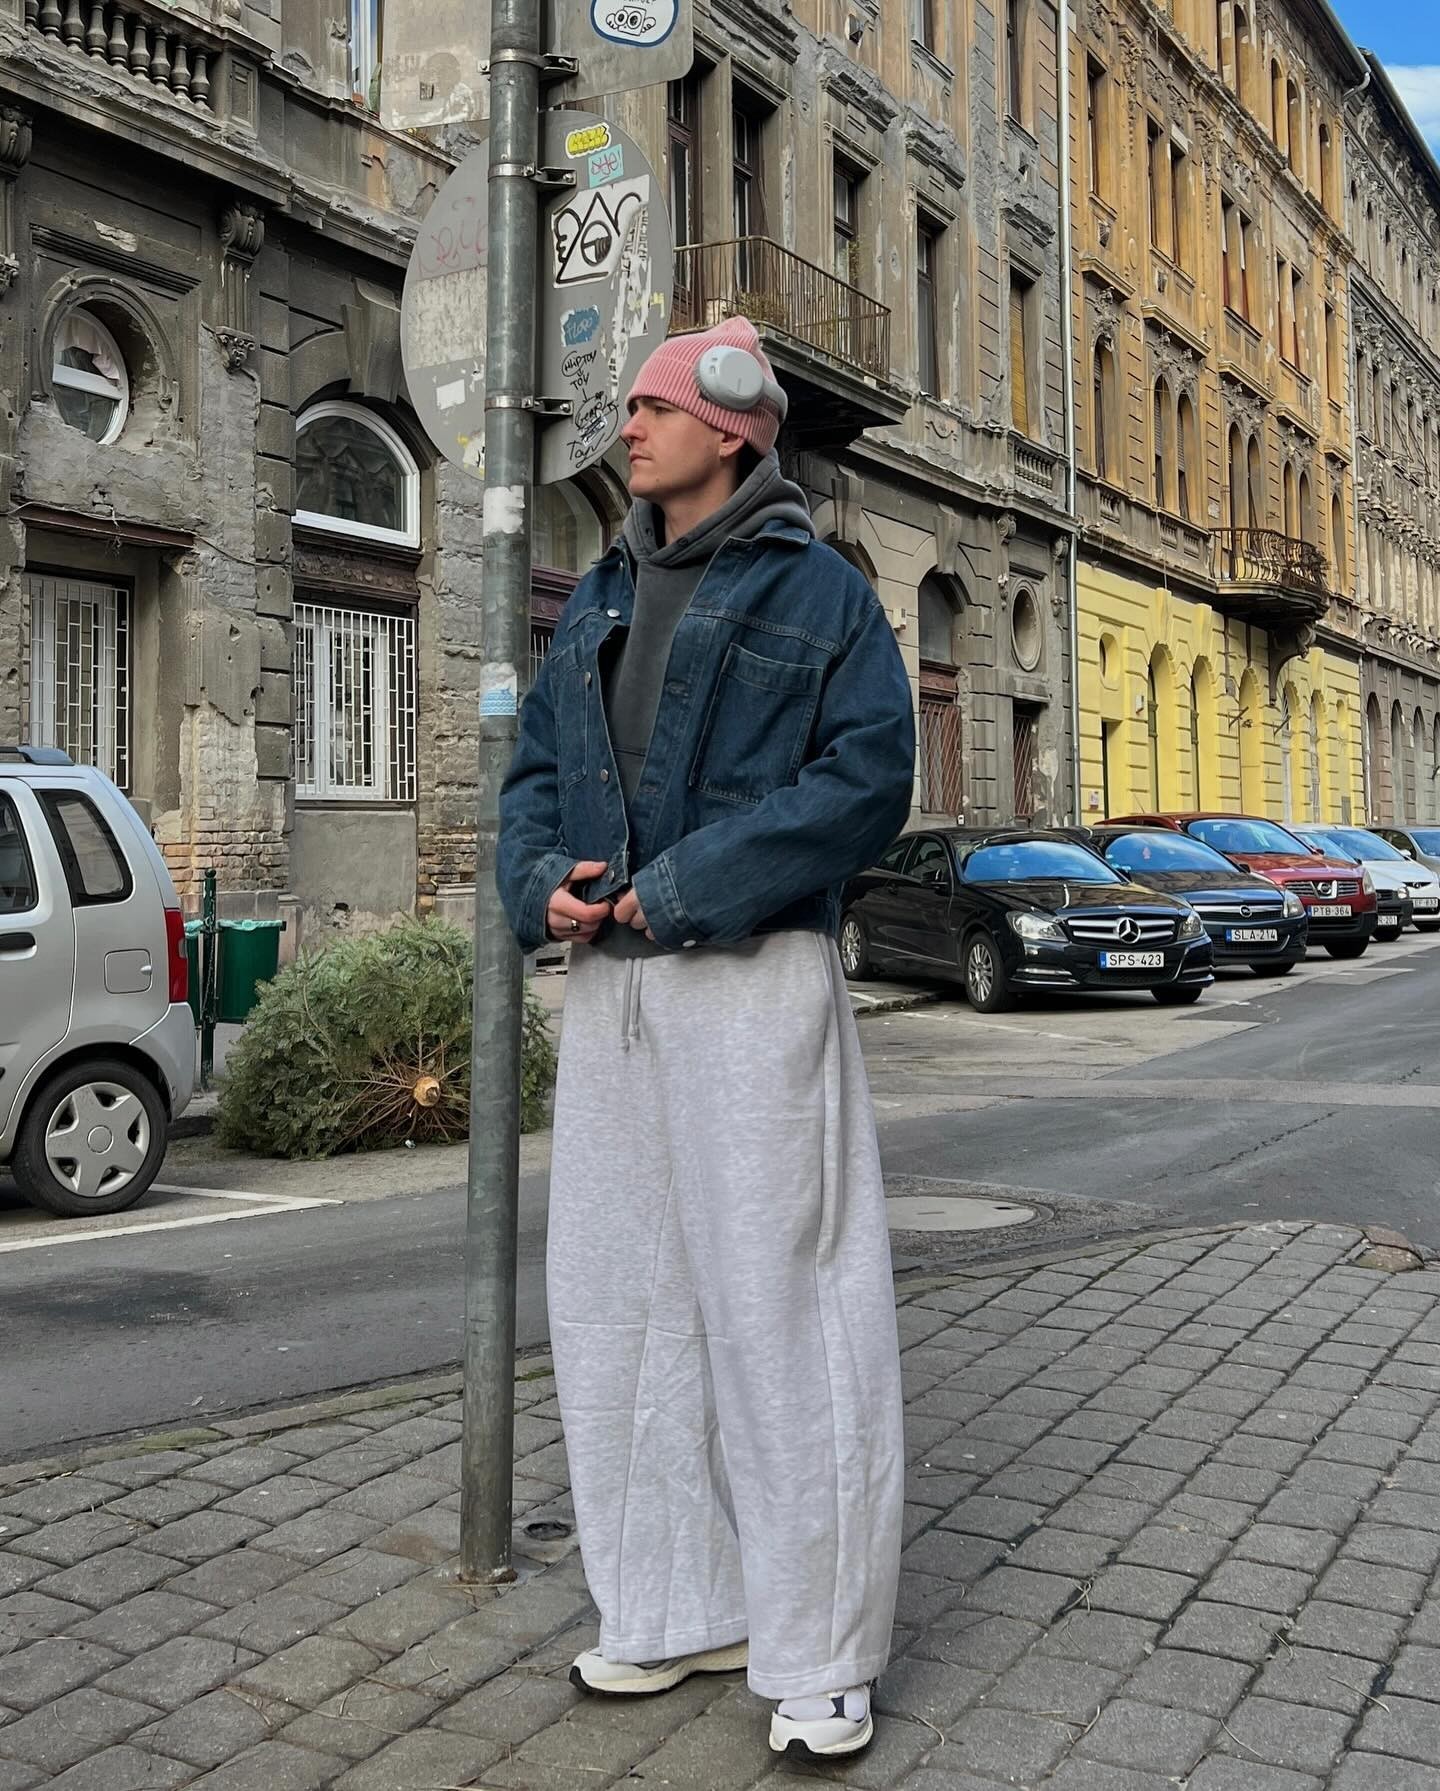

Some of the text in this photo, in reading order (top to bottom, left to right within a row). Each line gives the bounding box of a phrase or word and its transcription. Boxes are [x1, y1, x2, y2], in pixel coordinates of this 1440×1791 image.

[1313, 906, 1350, 916] PTB-364
[1233, 929, 1277, 941] SLA-214
[1109, 954, 1161, 966] SPS-423
